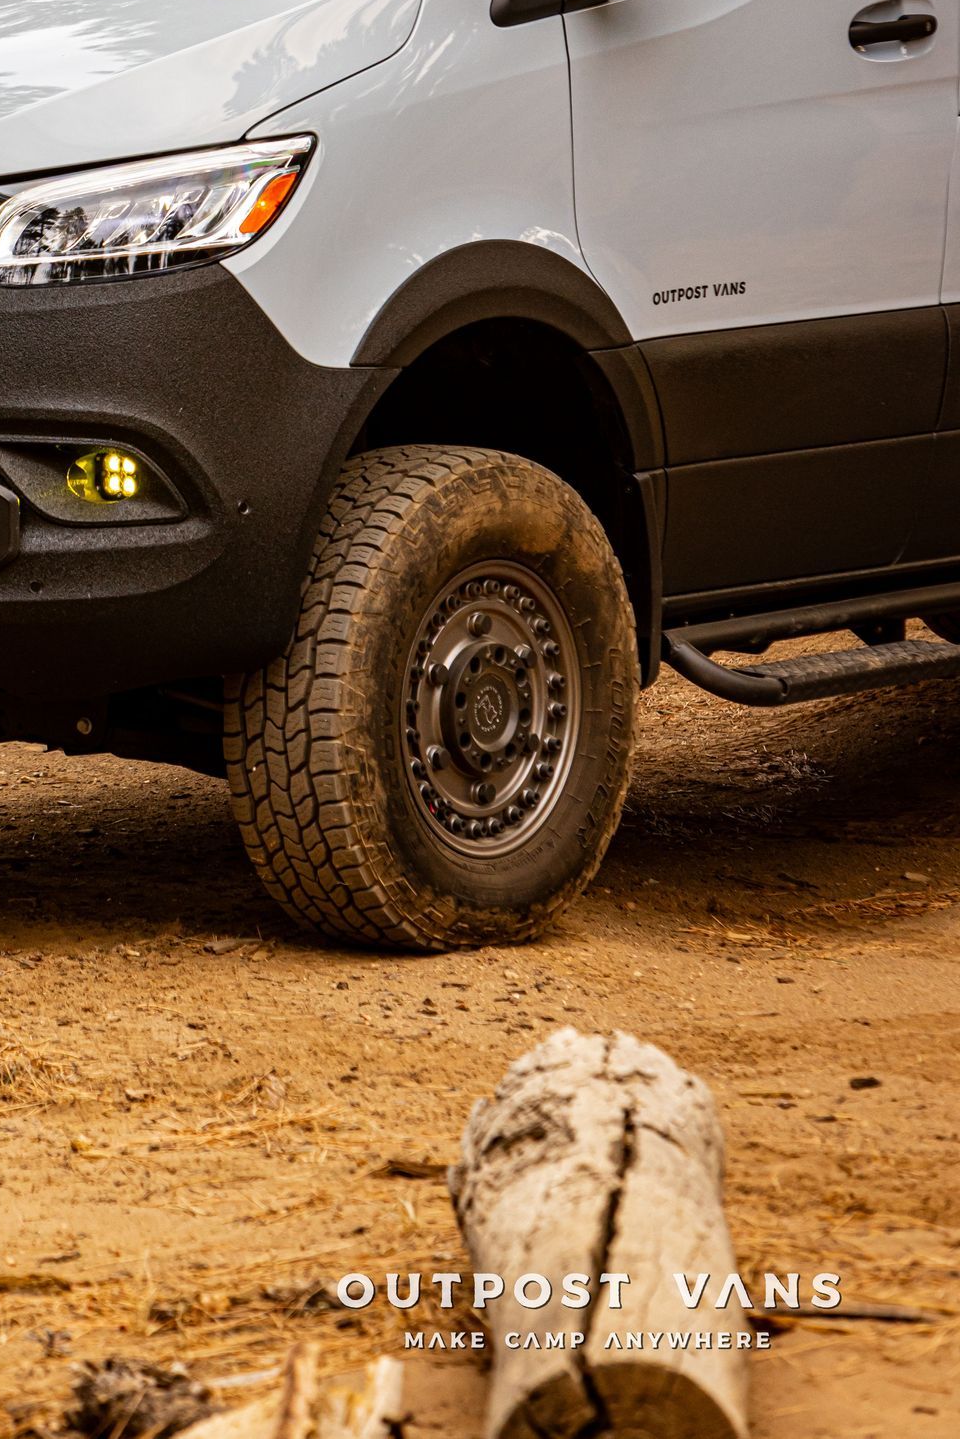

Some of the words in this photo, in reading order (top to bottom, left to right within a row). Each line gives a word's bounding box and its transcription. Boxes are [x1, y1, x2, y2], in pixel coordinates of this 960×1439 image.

[652, 285, 709, 306] OUTPOST
[713, 281, 746, 297] VANS
[575, 647, 626, 849] COOPER
